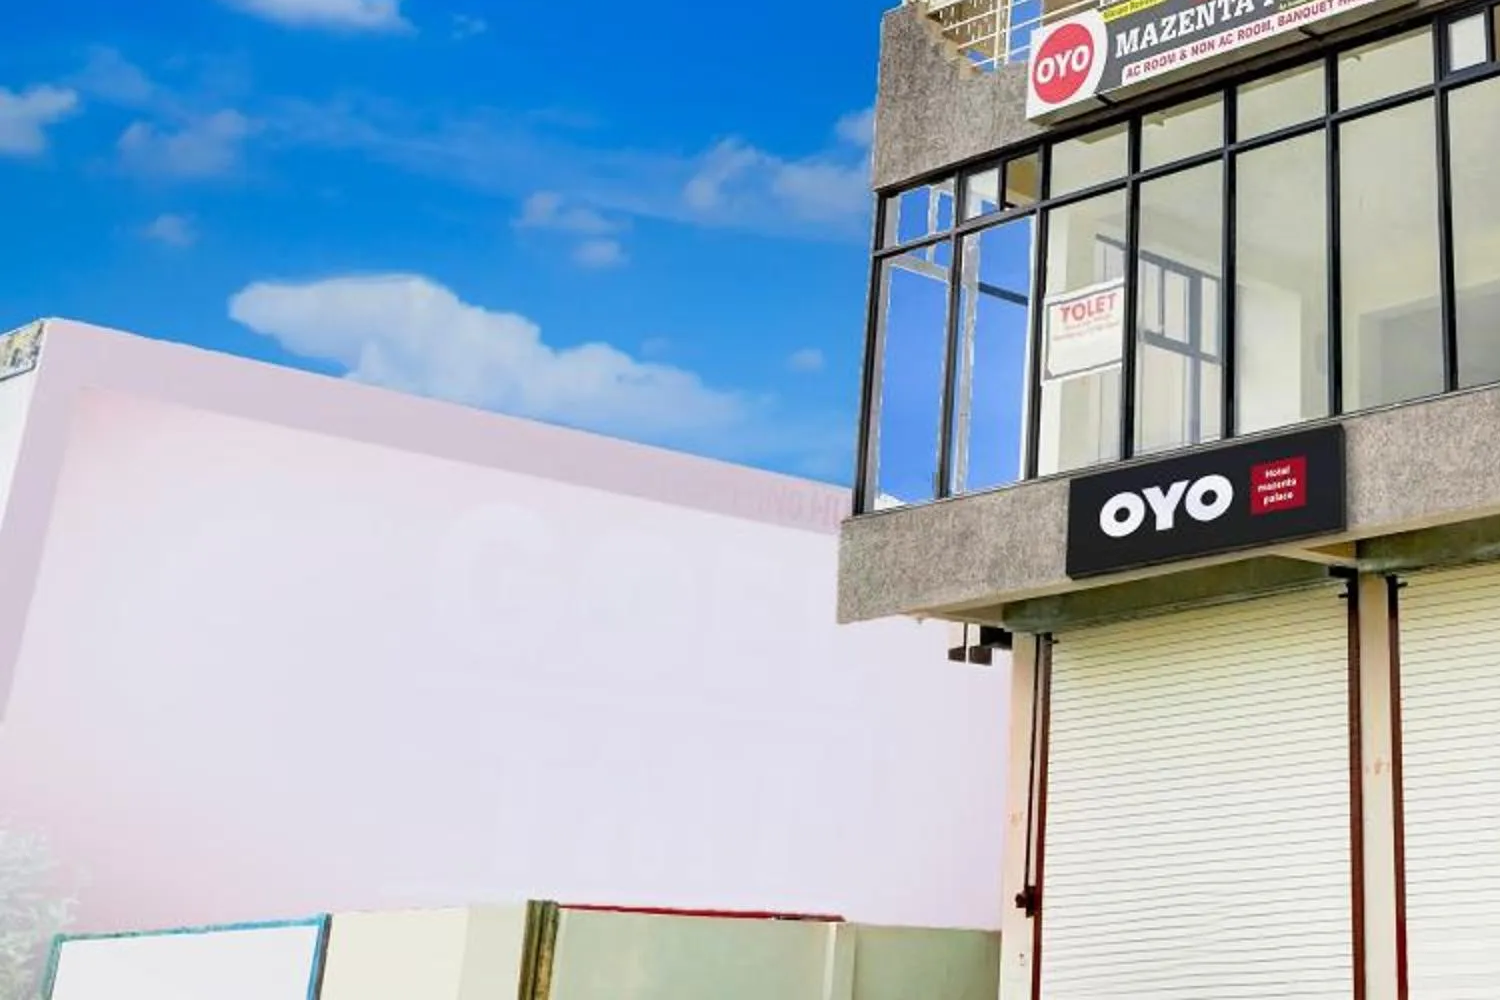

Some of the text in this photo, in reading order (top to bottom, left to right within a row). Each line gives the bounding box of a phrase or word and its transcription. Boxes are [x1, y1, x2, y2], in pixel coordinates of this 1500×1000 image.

[1036, 45, 1090, 84] OYO
[1126, 64, 1142, 79] AC
[1144, 51, 1177, 74] ROOM
[1180, 47, 1188, 61] &
[1191, 38, 1216, 58] NON
[1218, 31, 1234, 48] AC
[1277, 0, 1334, 28] BANQUET
[1100, 474, 1234, 537] OYO
